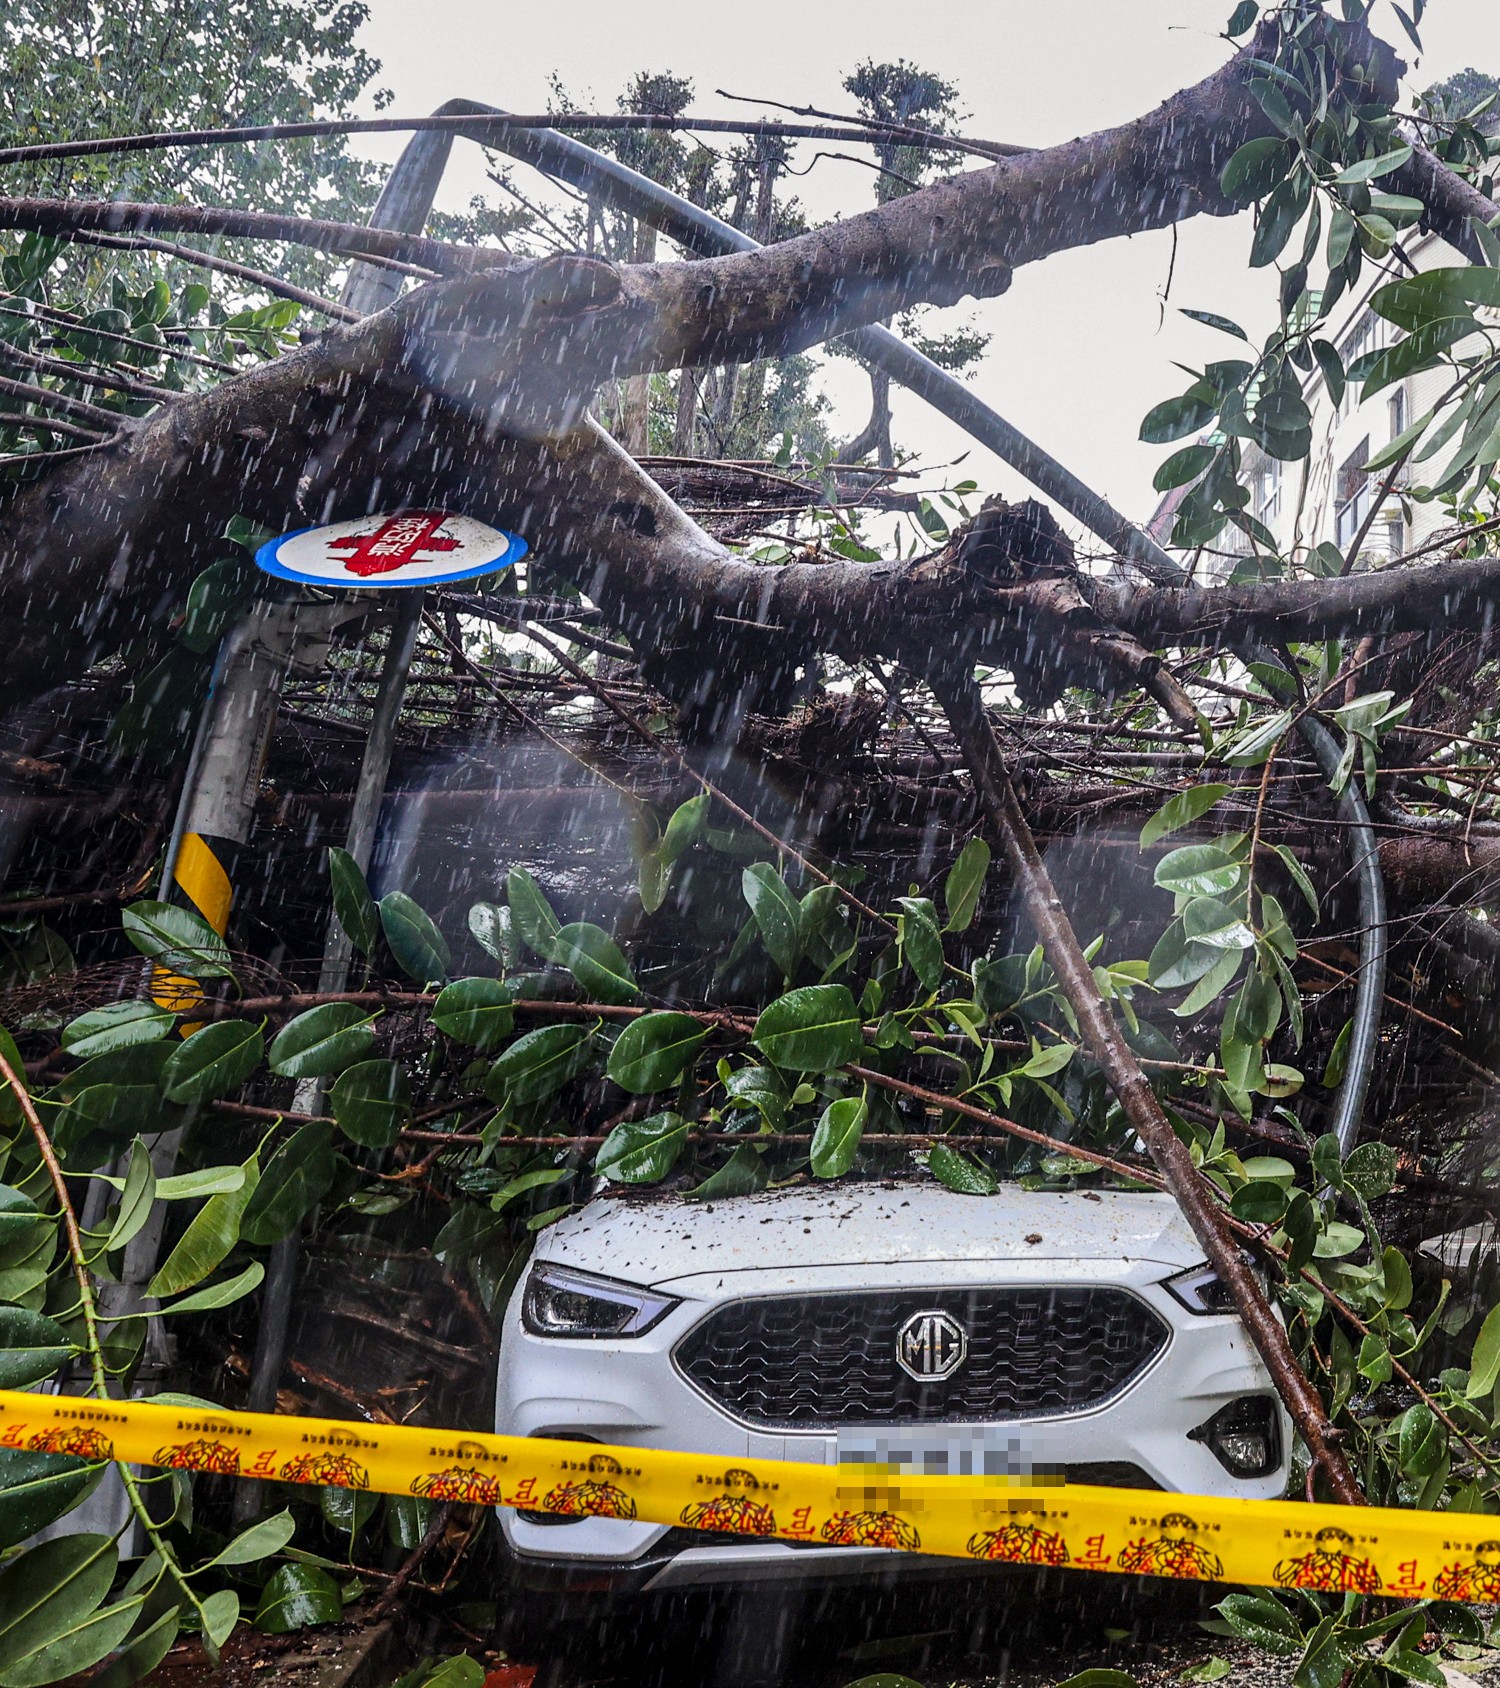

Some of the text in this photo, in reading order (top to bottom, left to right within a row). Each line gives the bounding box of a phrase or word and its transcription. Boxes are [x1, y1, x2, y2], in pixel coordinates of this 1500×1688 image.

[367, 517, 431, 556] 消防栓
[905, 1316, 960, 1373] MG
